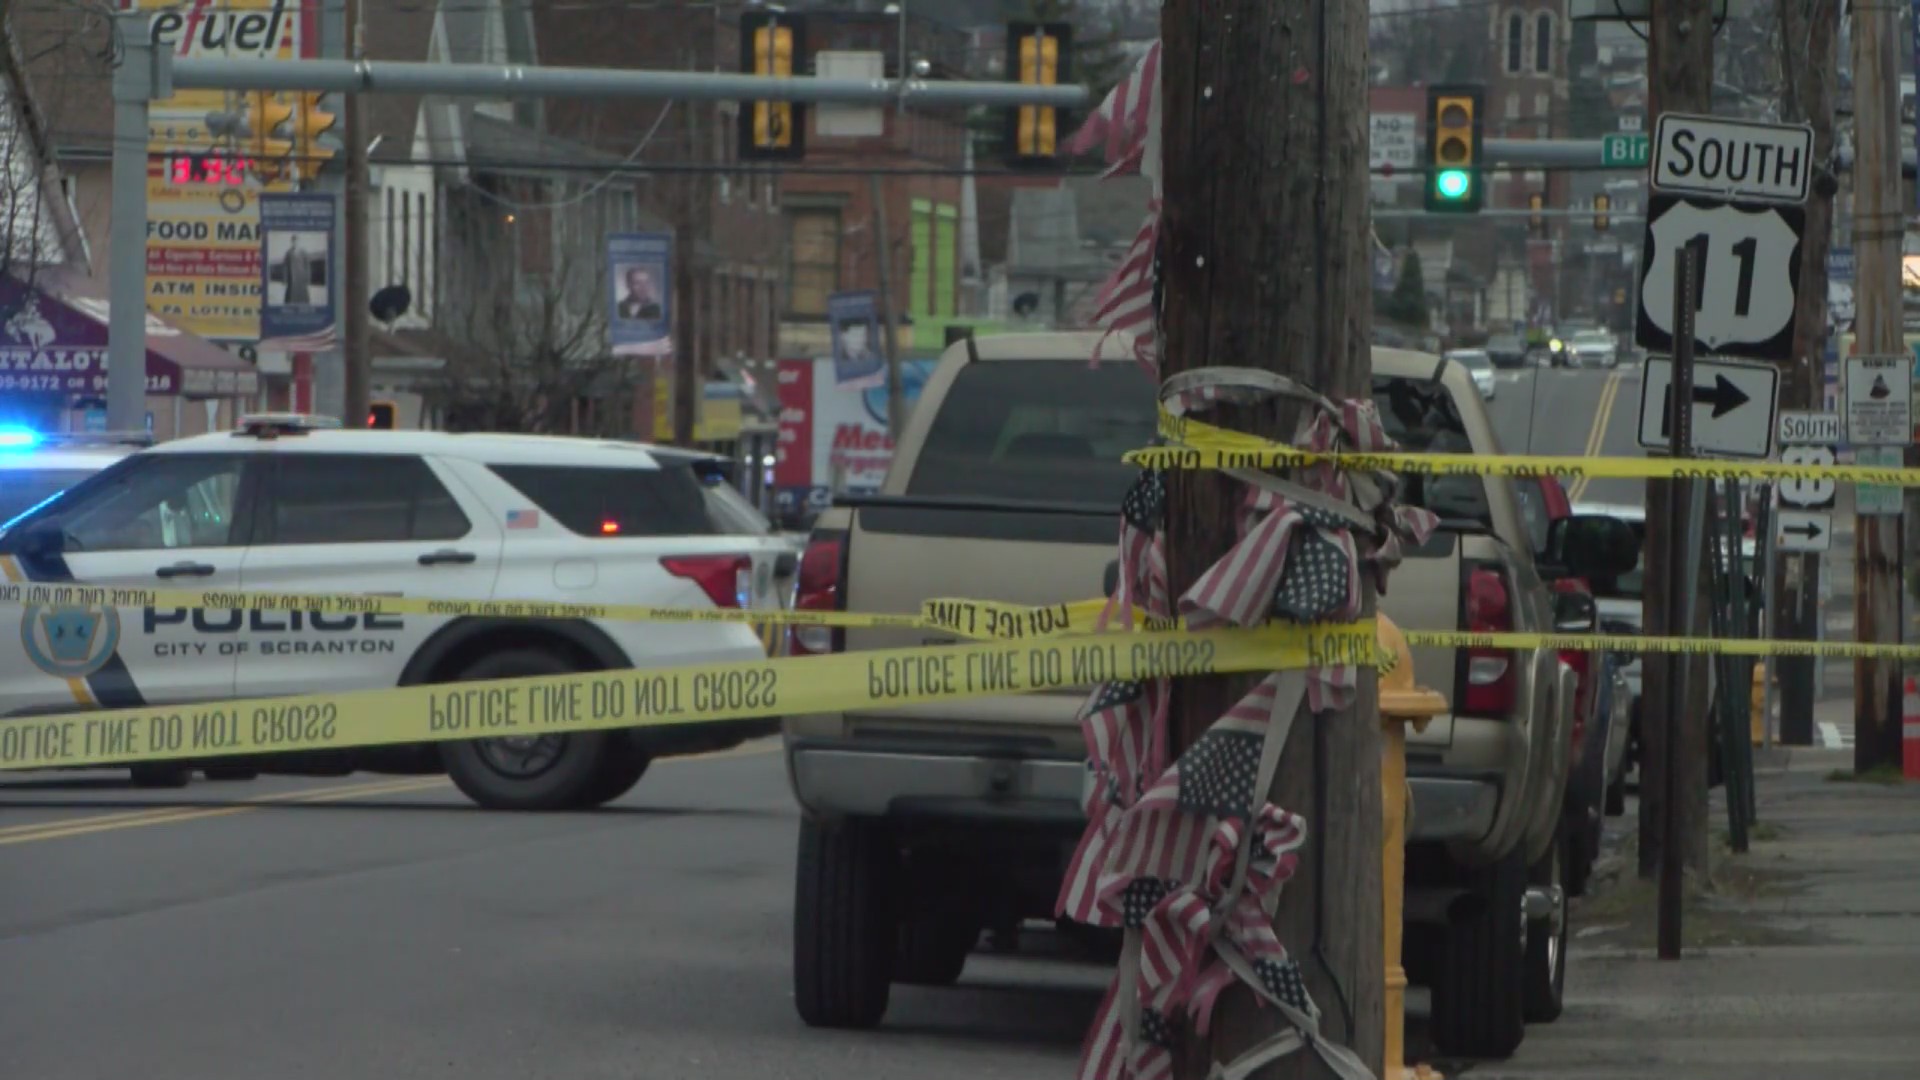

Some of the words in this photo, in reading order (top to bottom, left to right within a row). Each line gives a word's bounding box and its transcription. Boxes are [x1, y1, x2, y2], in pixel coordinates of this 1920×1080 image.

[1667, 128, 1799, 187] SOUTH
[146, 221, 208, 240] FOOD
[1684, 232, 1757, 316] 11
[152, 282, 195, 295] ATM
[162, 305, 182, 315] PA
[1784, 416, 1838, 438] SOUTH
[154, 642, 206, 657] CITY
[219, 641, 248, 655] OF
[260, 639, 395, 655] SCRANTON
